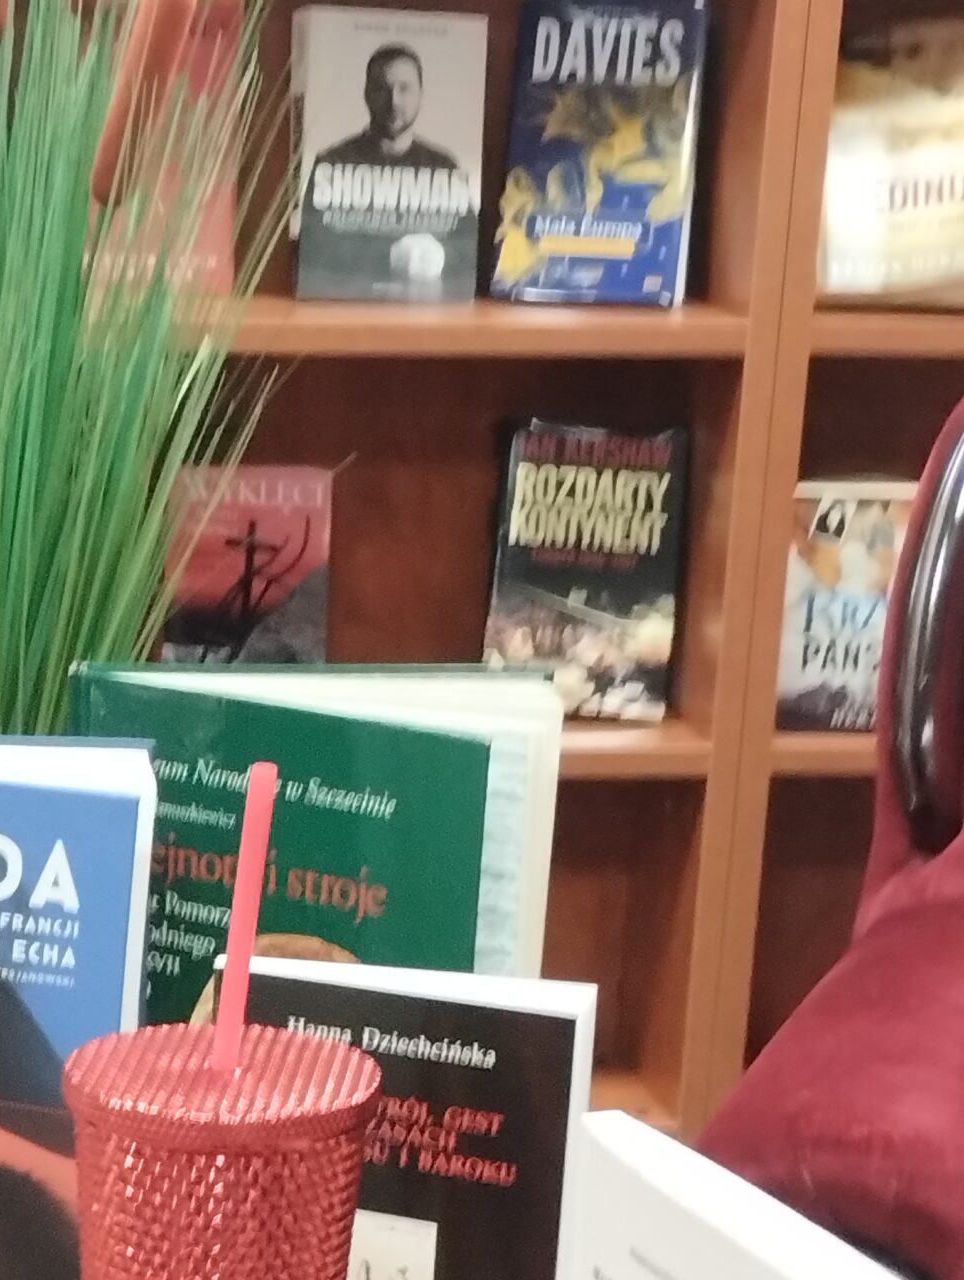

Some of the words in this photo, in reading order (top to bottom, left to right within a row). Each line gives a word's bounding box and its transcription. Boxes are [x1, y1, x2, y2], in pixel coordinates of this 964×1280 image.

[532, 15, 686, 87] DAVIES
[312, 162, 470, 217] SHOWMAN
[514, 462, 672, 511] ROZDARTY
[508, 500, 668, 556] KONTYNENT
[285, 779, 304, 803] w
[164, 889, 232, 929] Pomorz
[287, 865, 388, 927] stroje
[0, 911, 80, 940] FRANCJI
[12, 938, 77, 969] ECHA
[287, 1015, 353, 1045] Hanna
[443, 1106, 505, 1137] GEST
[418, 1147, 518, 1188] BAROKU
